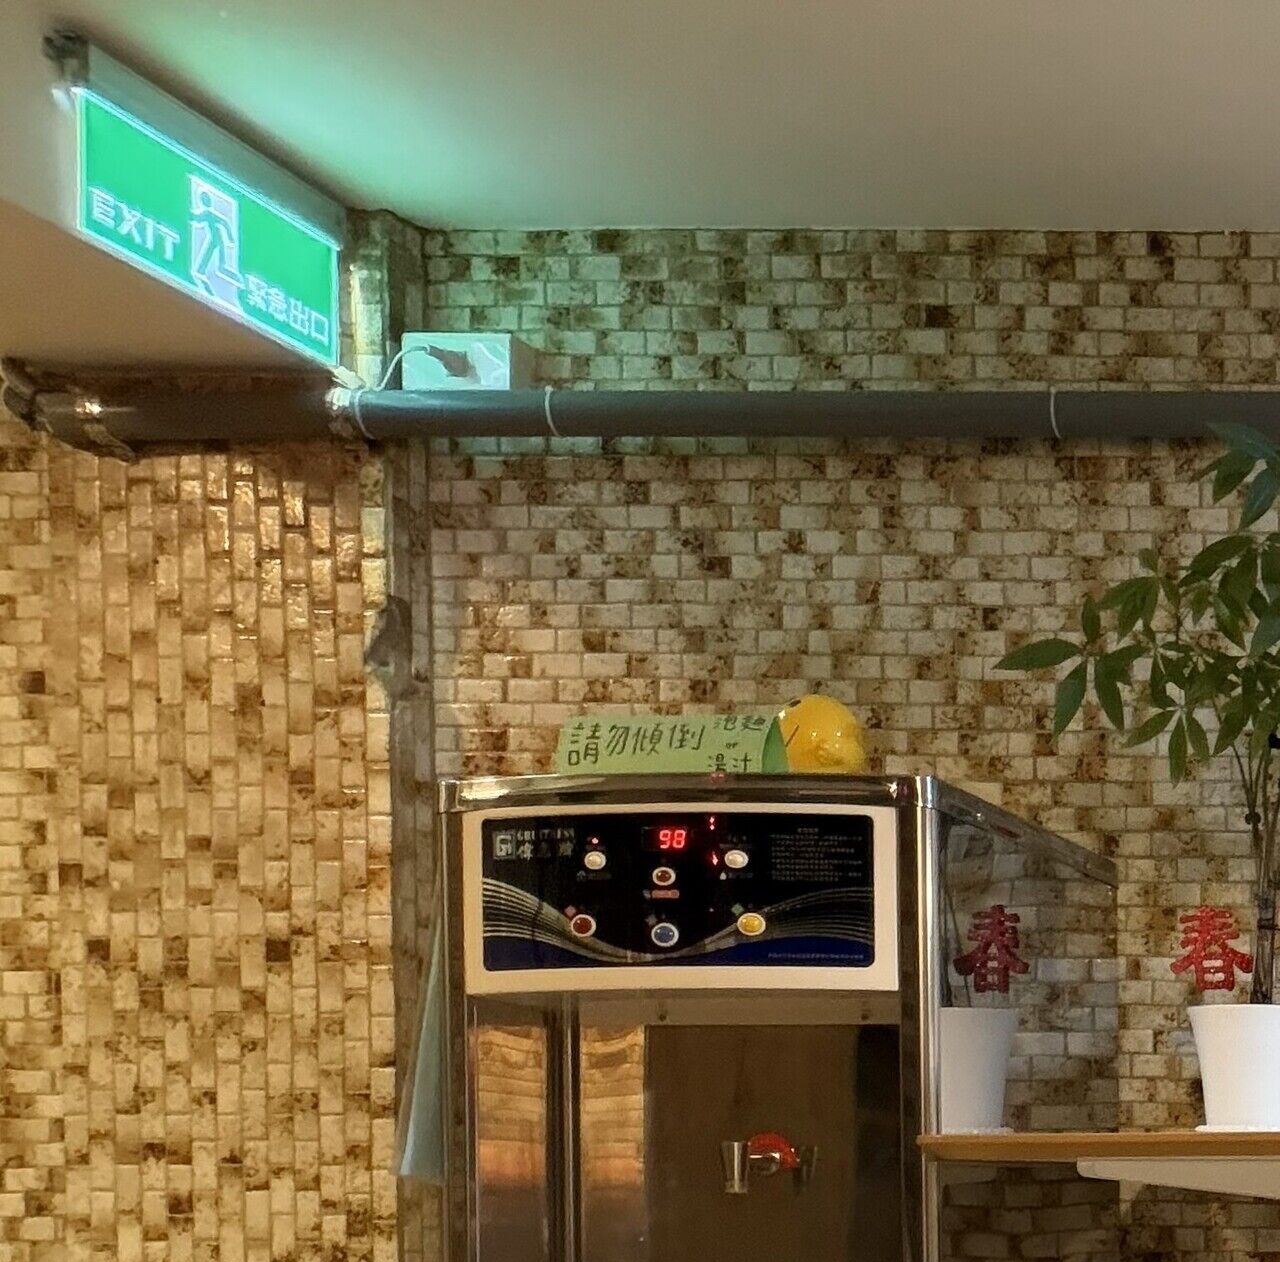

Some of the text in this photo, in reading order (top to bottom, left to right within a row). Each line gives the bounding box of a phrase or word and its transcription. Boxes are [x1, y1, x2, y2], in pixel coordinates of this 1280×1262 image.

[89, 186, 180, 261] EXIT
[244, 273, 330, 346] 緊急出口
[567, 722, 706, 767] 請勿傾倒
[708, 752, 753, 773] 湯汁
[725, 741, 739, 749] or
[658, 829, 687, 849] 98
[1170, 904, 1254, 992] 春
